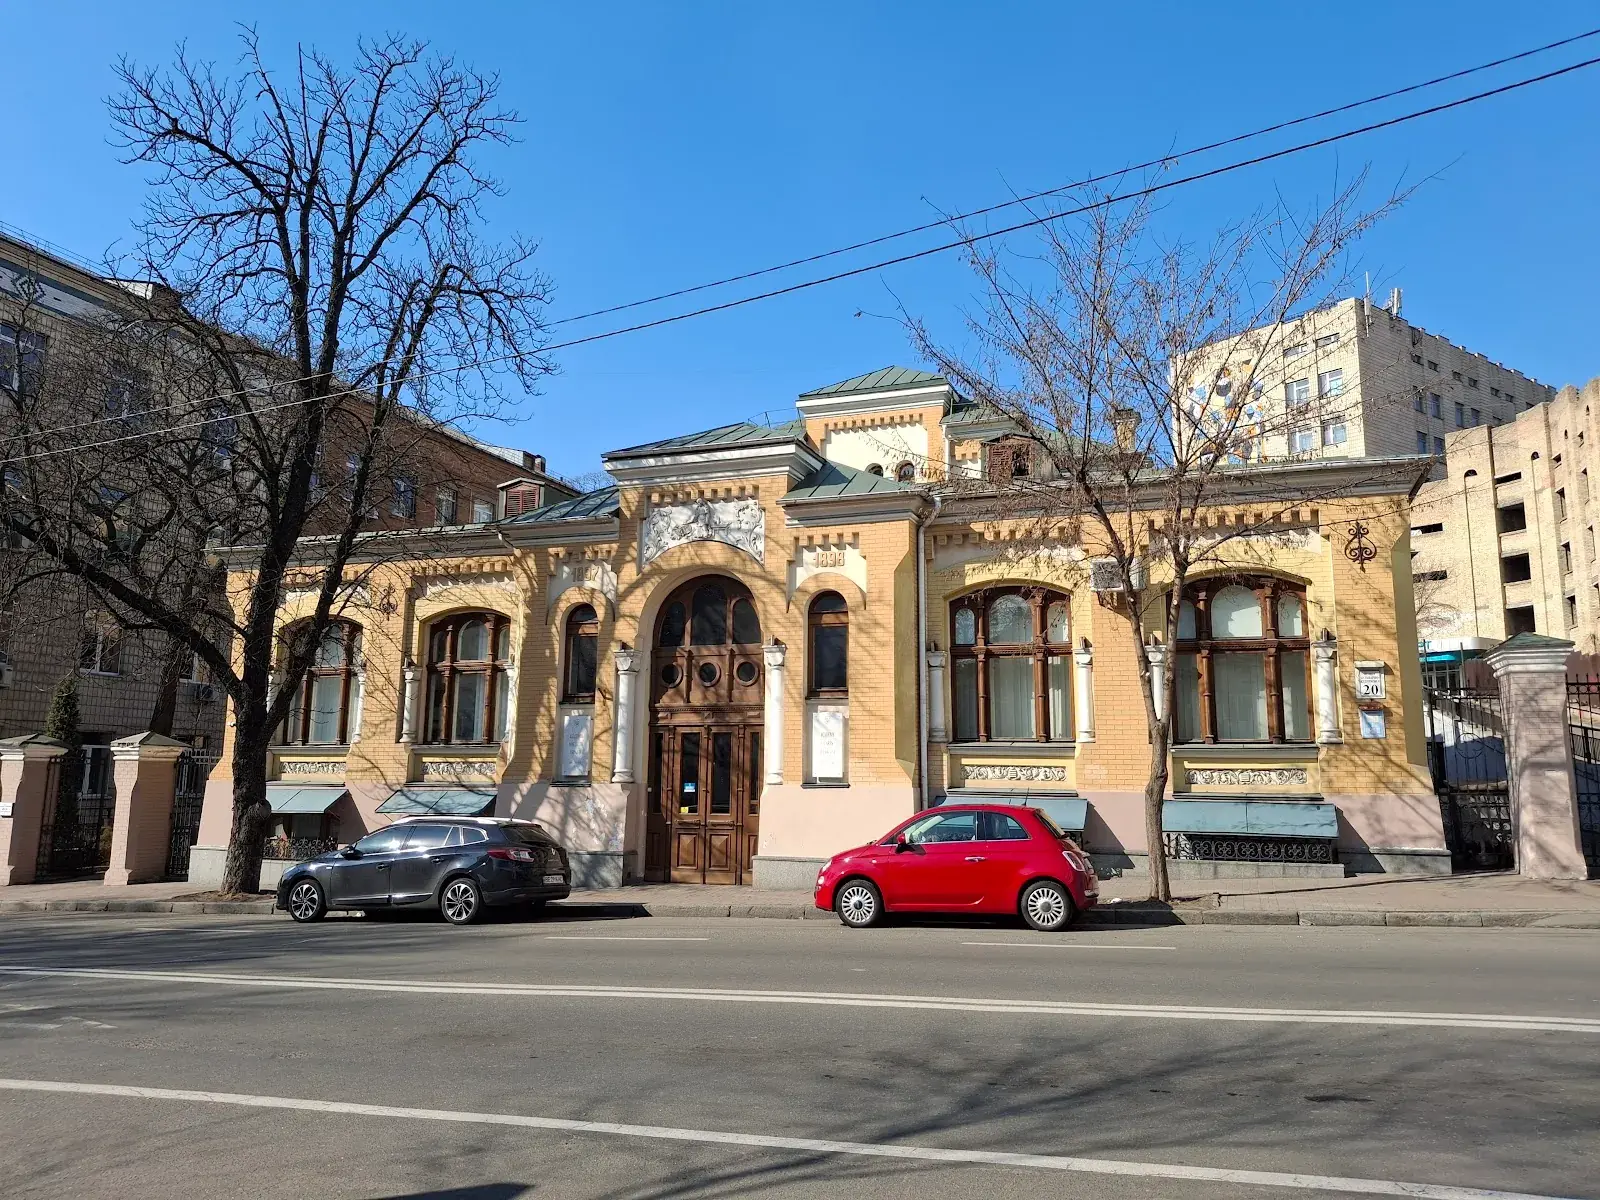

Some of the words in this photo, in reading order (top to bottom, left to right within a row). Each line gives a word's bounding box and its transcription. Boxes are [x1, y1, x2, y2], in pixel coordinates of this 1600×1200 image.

[813, 551, 845, 568] 1898
[571, 566, 600, 582] 1897
[1363, 684, 1379, 695] 20
